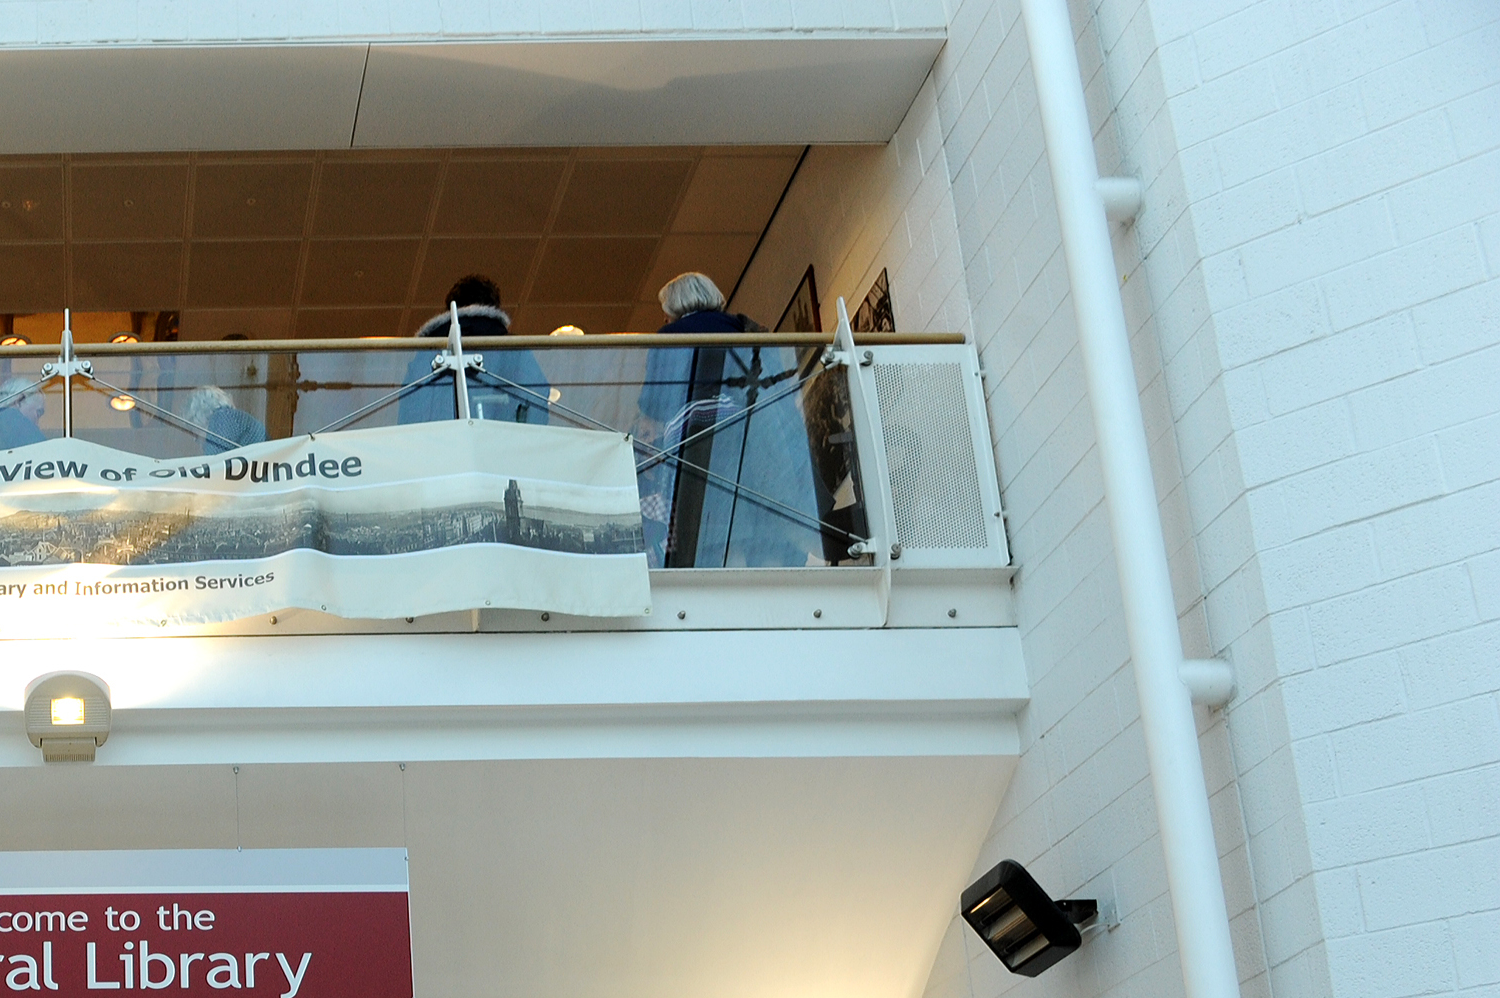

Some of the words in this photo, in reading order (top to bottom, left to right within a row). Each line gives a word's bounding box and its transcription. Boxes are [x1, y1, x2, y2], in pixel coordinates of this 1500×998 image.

[100, 466, 137, 482] of
[224, 453, 362, 484] Dundee
[33, 580, 67, 596] and
[75, 577, 189, 596] Information
[195, 571, 275, 590] Services
[104, 906, 141, 932] to
[156, 903, 216, 931] the
